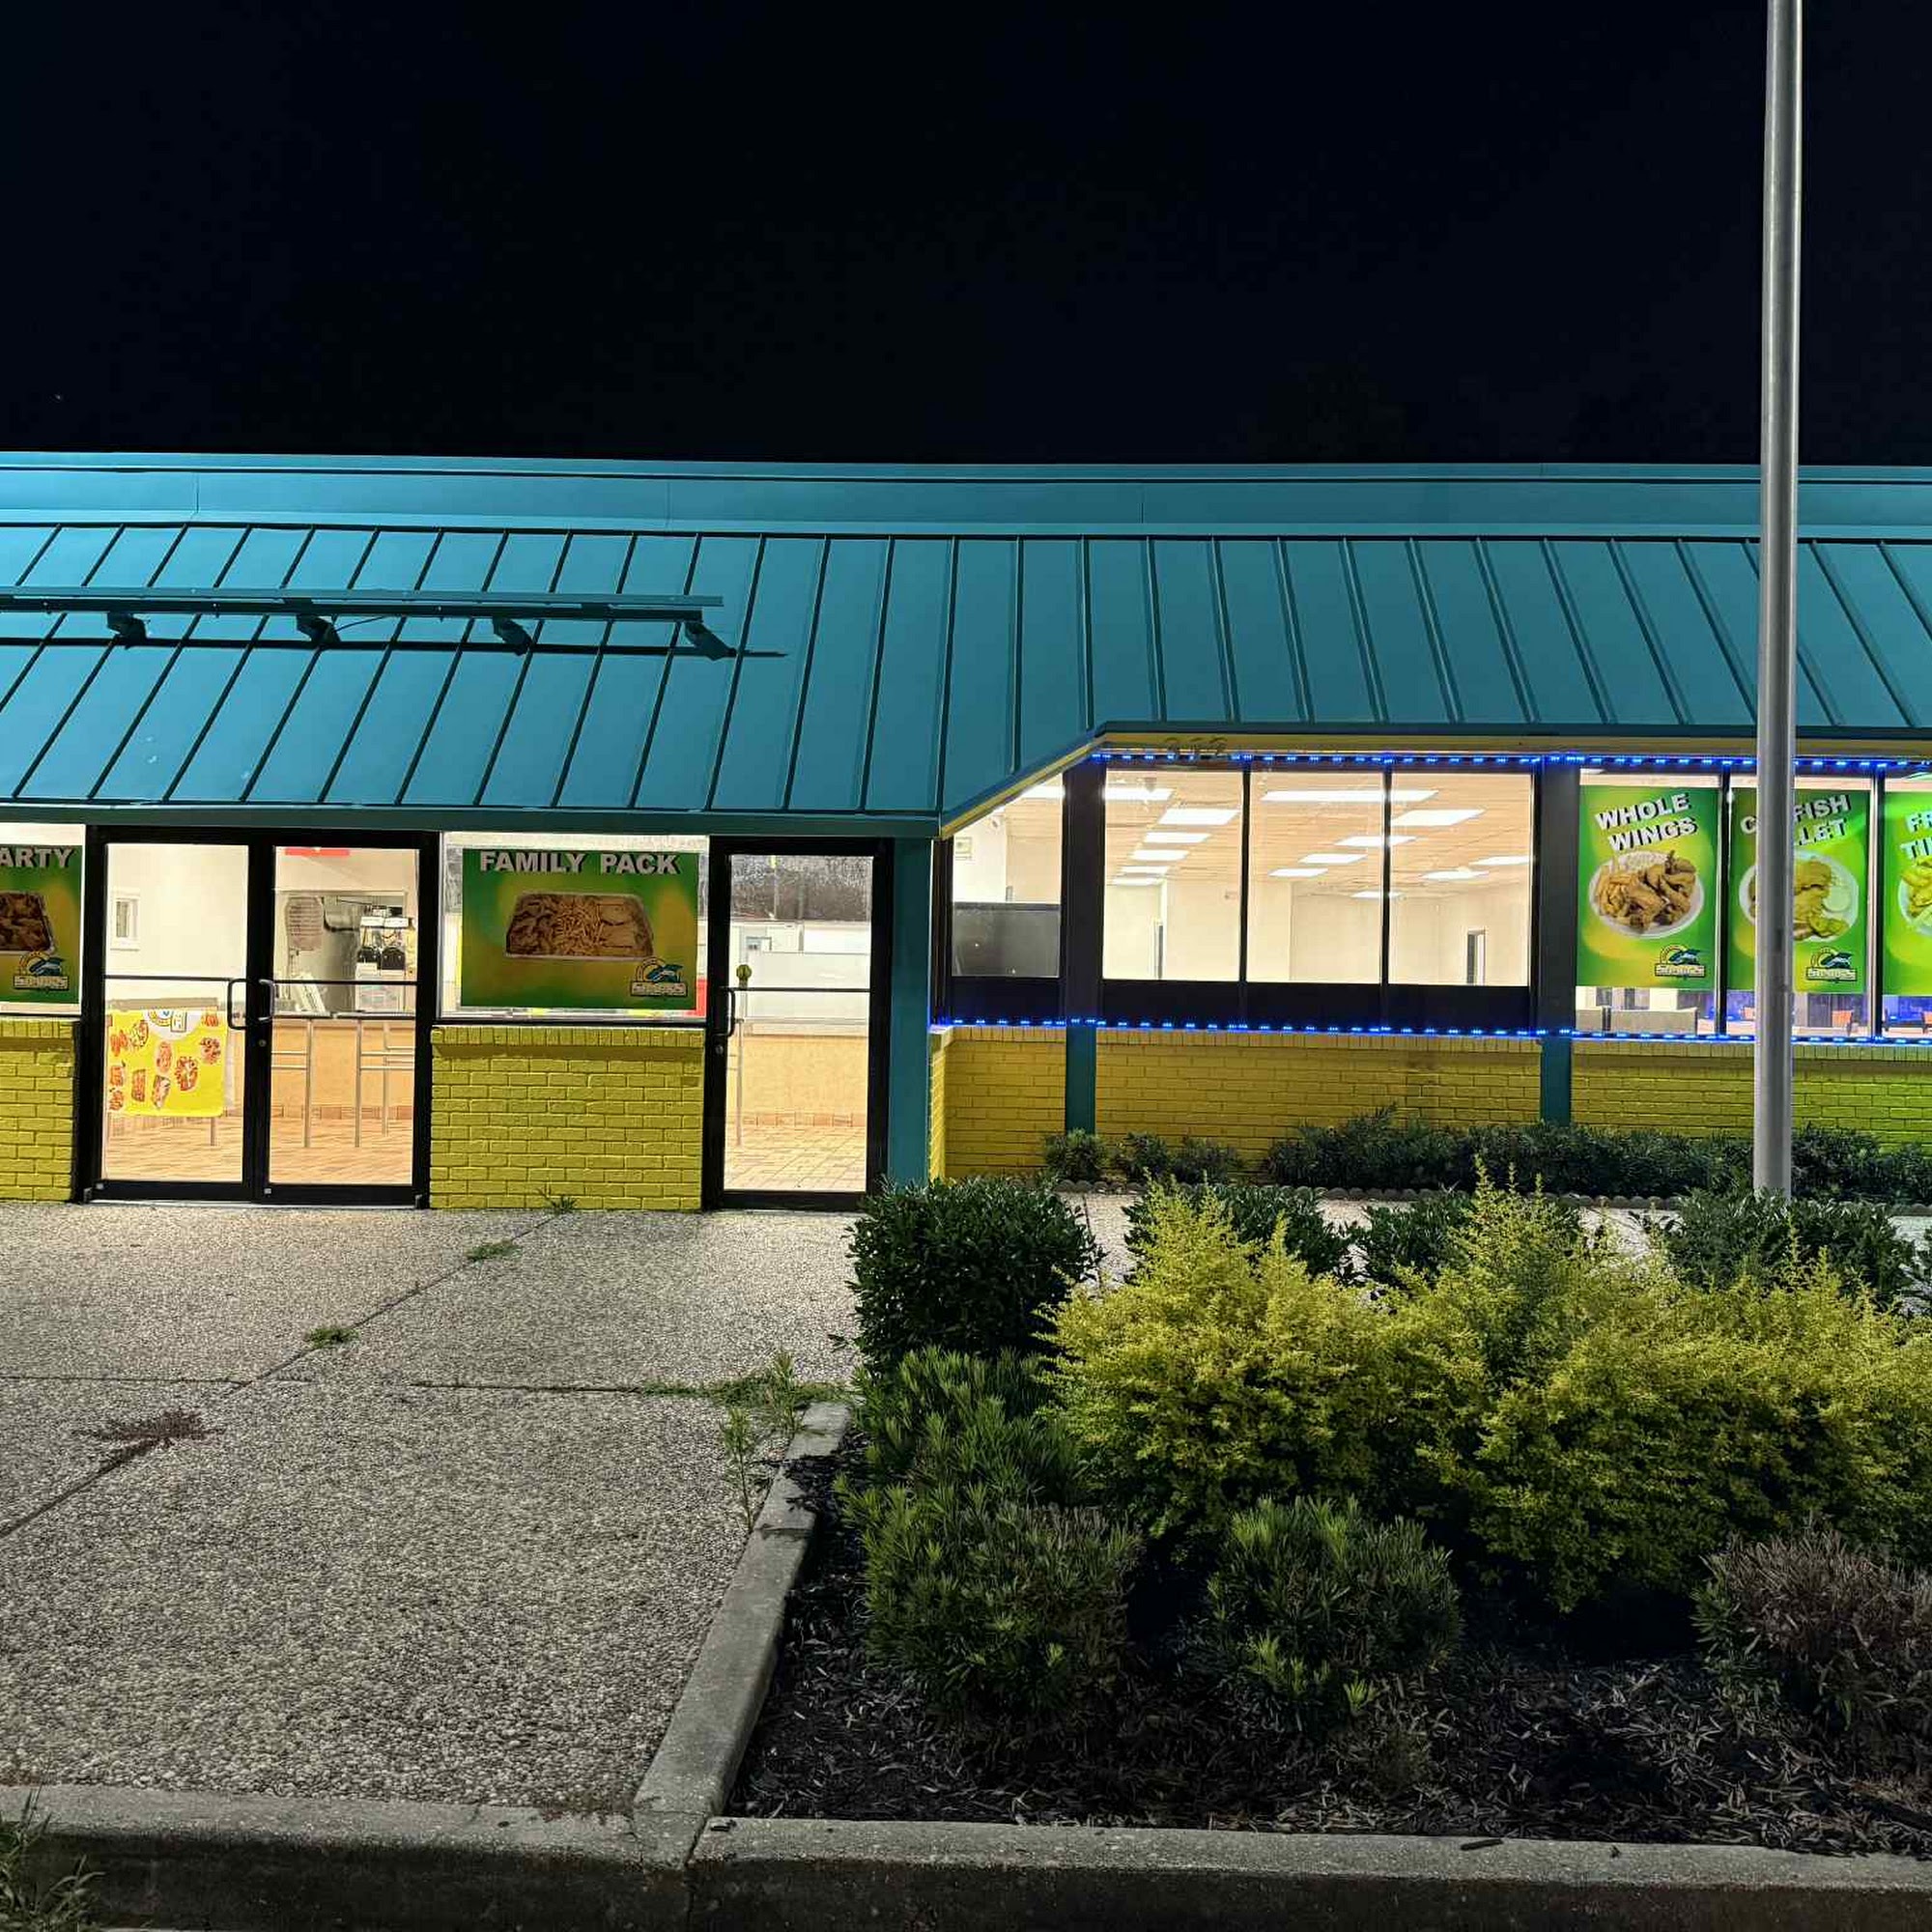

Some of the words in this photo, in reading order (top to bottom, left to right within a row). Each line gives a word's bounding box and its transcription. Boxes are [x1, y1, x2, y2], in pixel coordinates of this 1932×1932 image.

[1595, 793, 1691, 830] WHOLE
[1740, 794, 1851, 835] CFISH
[1607, 817, 1698, 850] WINGS
[0, 847, 73, 867] ARTY
[480, 850, 584, 873] FAMILY
[600, 854, 680, 874] PACK
